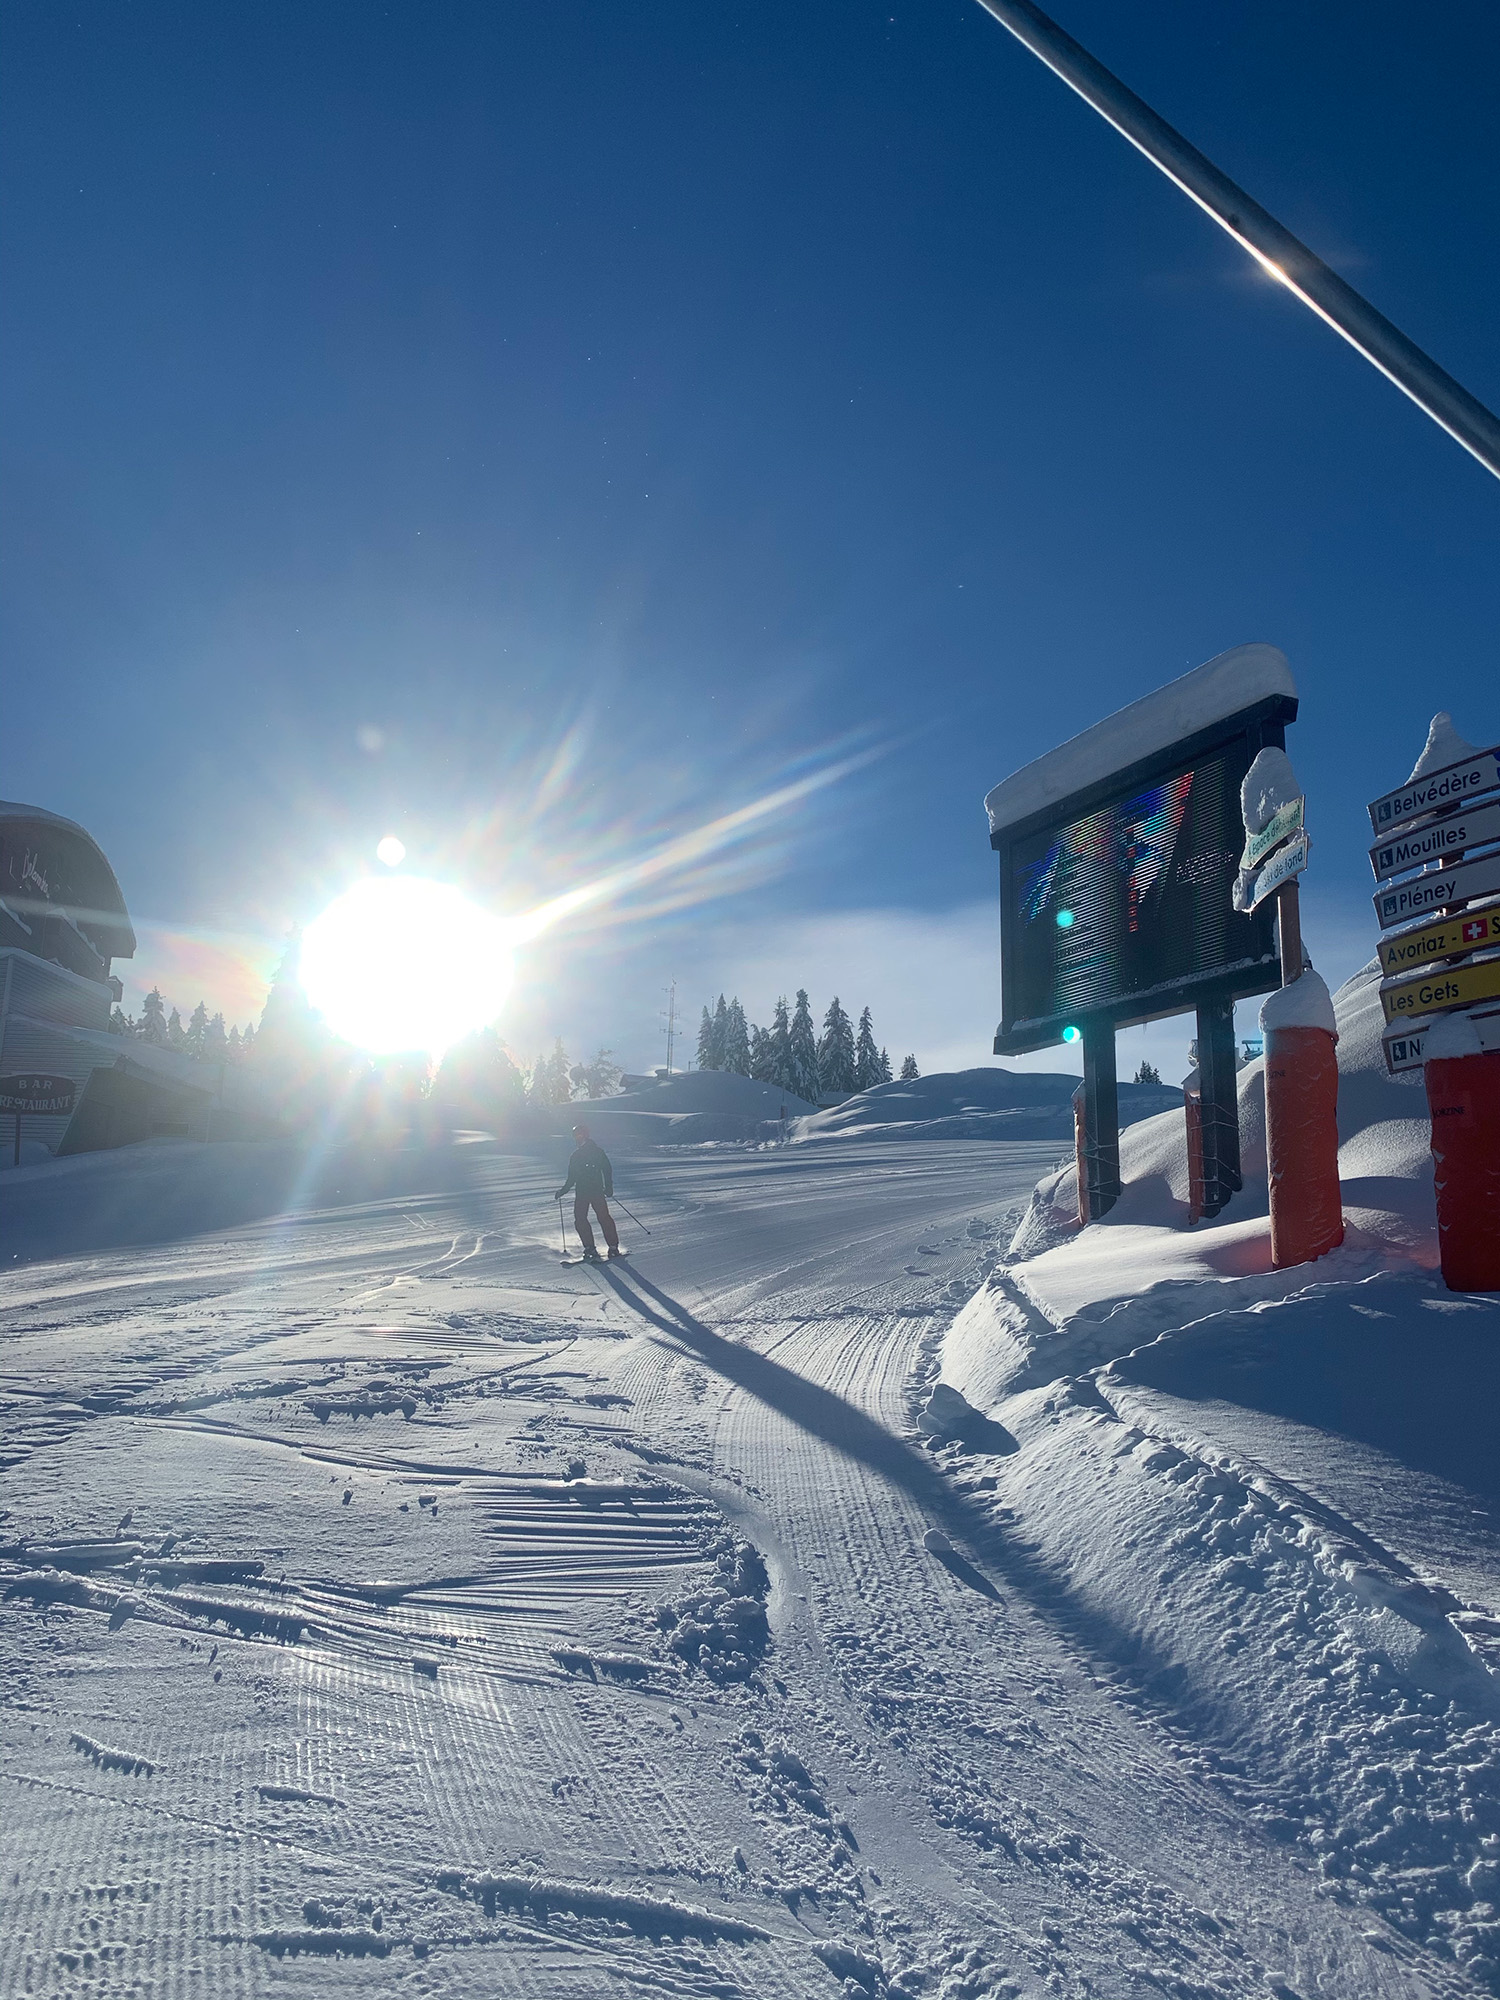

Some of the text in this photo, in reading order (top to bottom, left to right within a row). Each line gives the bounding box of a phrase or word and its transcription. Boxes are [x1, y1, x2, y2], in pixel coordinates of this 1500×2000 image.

[1394, 770, 1481, 816] Belvédère
[1396, 826, 1467, 863] Mouilles
[1399, 880, 1456, 911] Pléney
[1387, 935, 1446, 965] Avoriaz
[1390, 981, 1459, 1012] Les Gets
[18, 1079, 53, 1090] BAR
